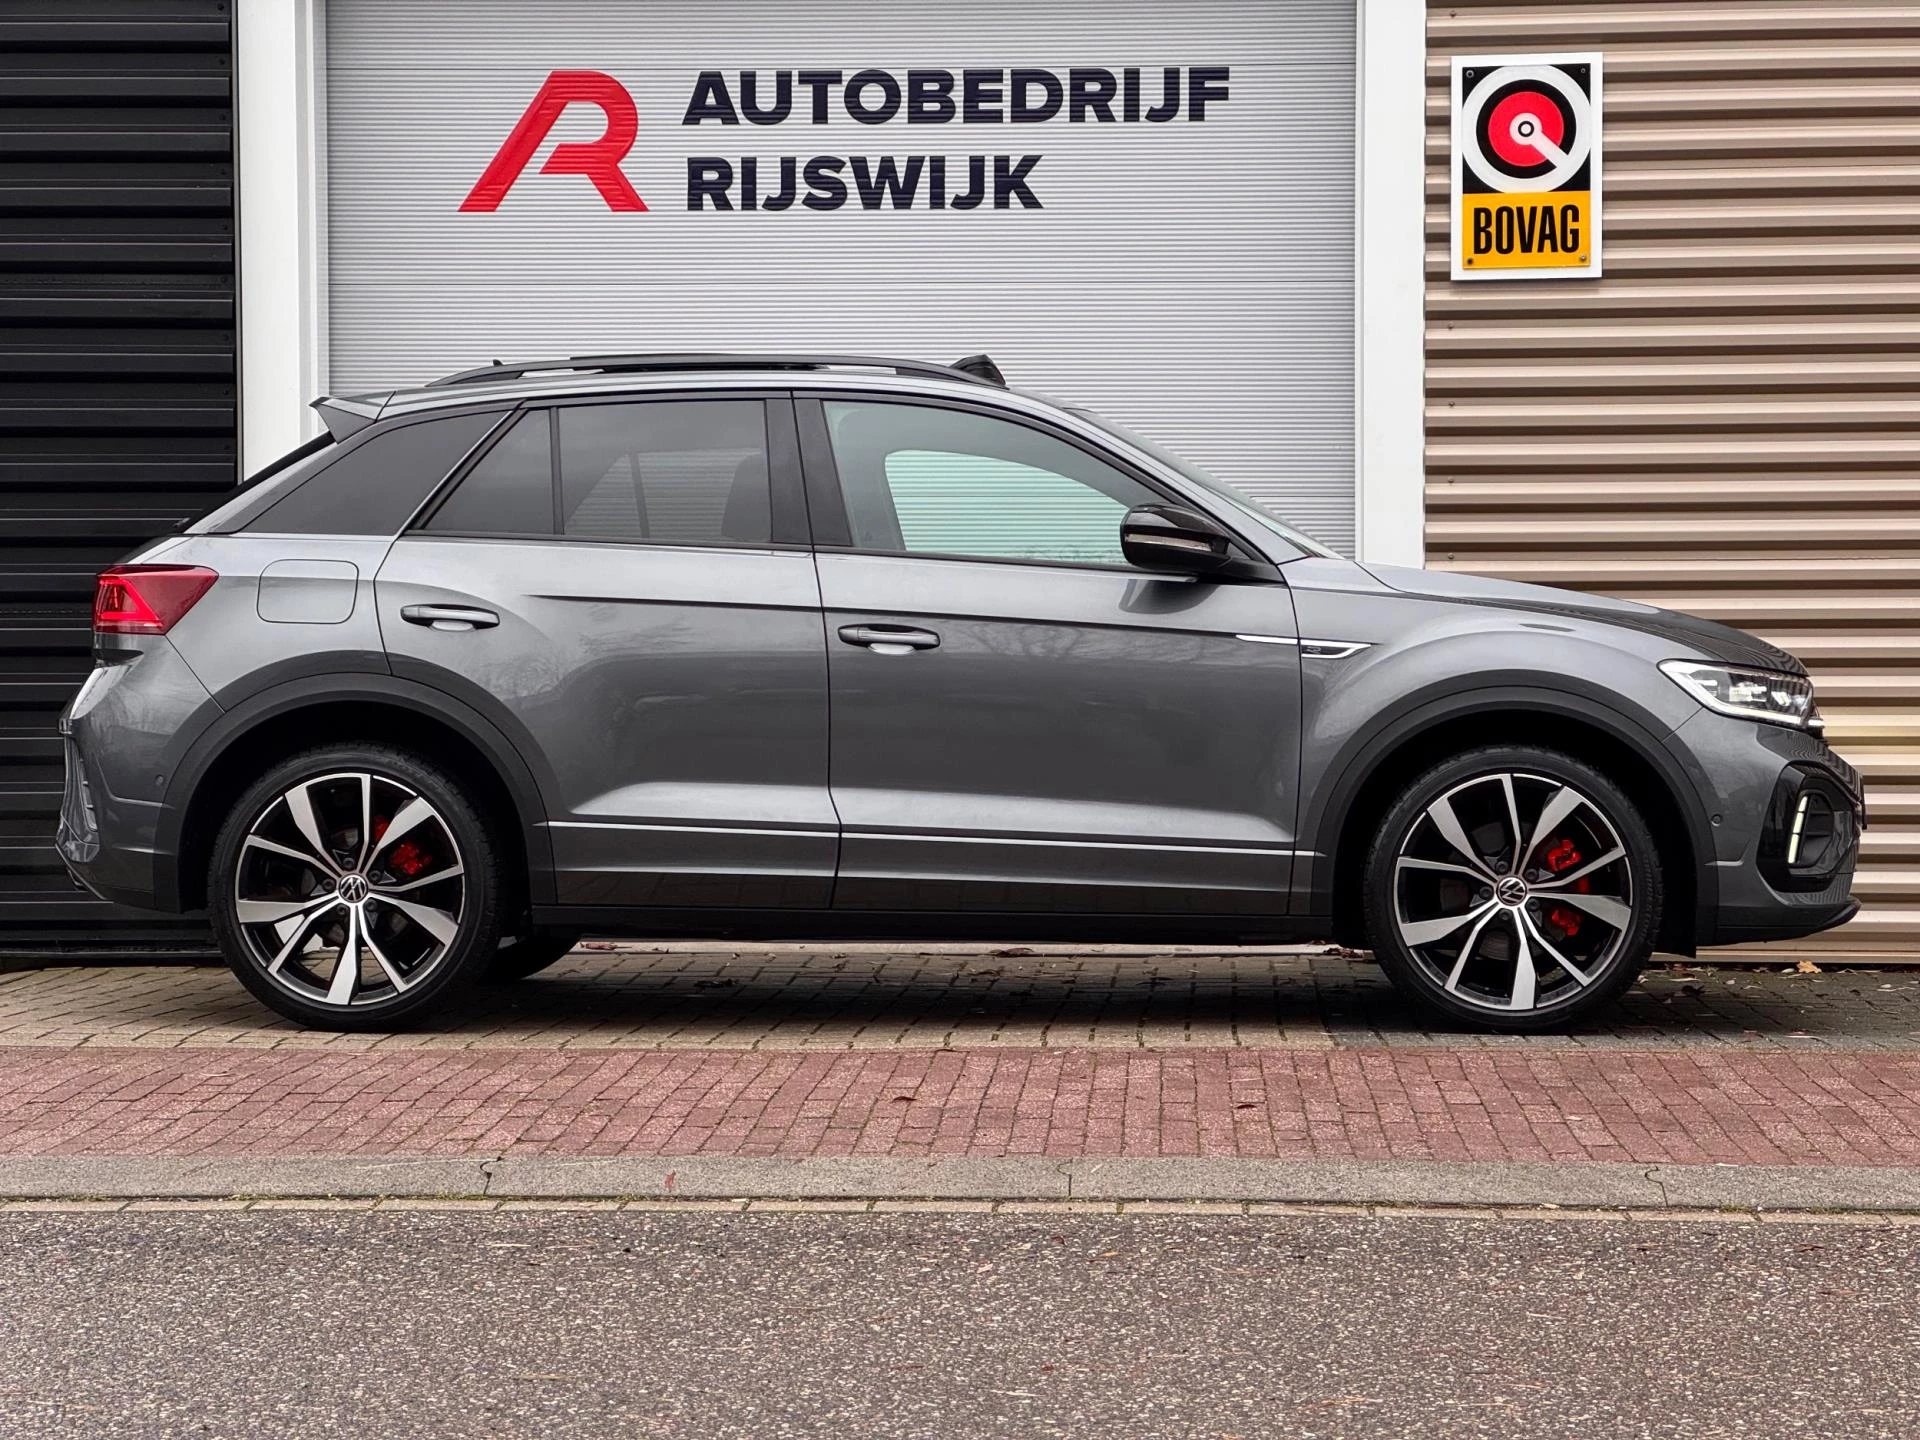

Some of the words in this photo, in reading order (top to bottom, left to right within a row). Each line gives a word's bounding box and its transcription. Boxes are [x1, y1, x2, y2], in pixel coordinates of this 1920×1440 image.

[682, 66, 1230, 126] AUTOBEDRIJF
[687, 154, 1044, 212] RIJSWIJK
[1473, 204, 1580, 255] BOVAG
